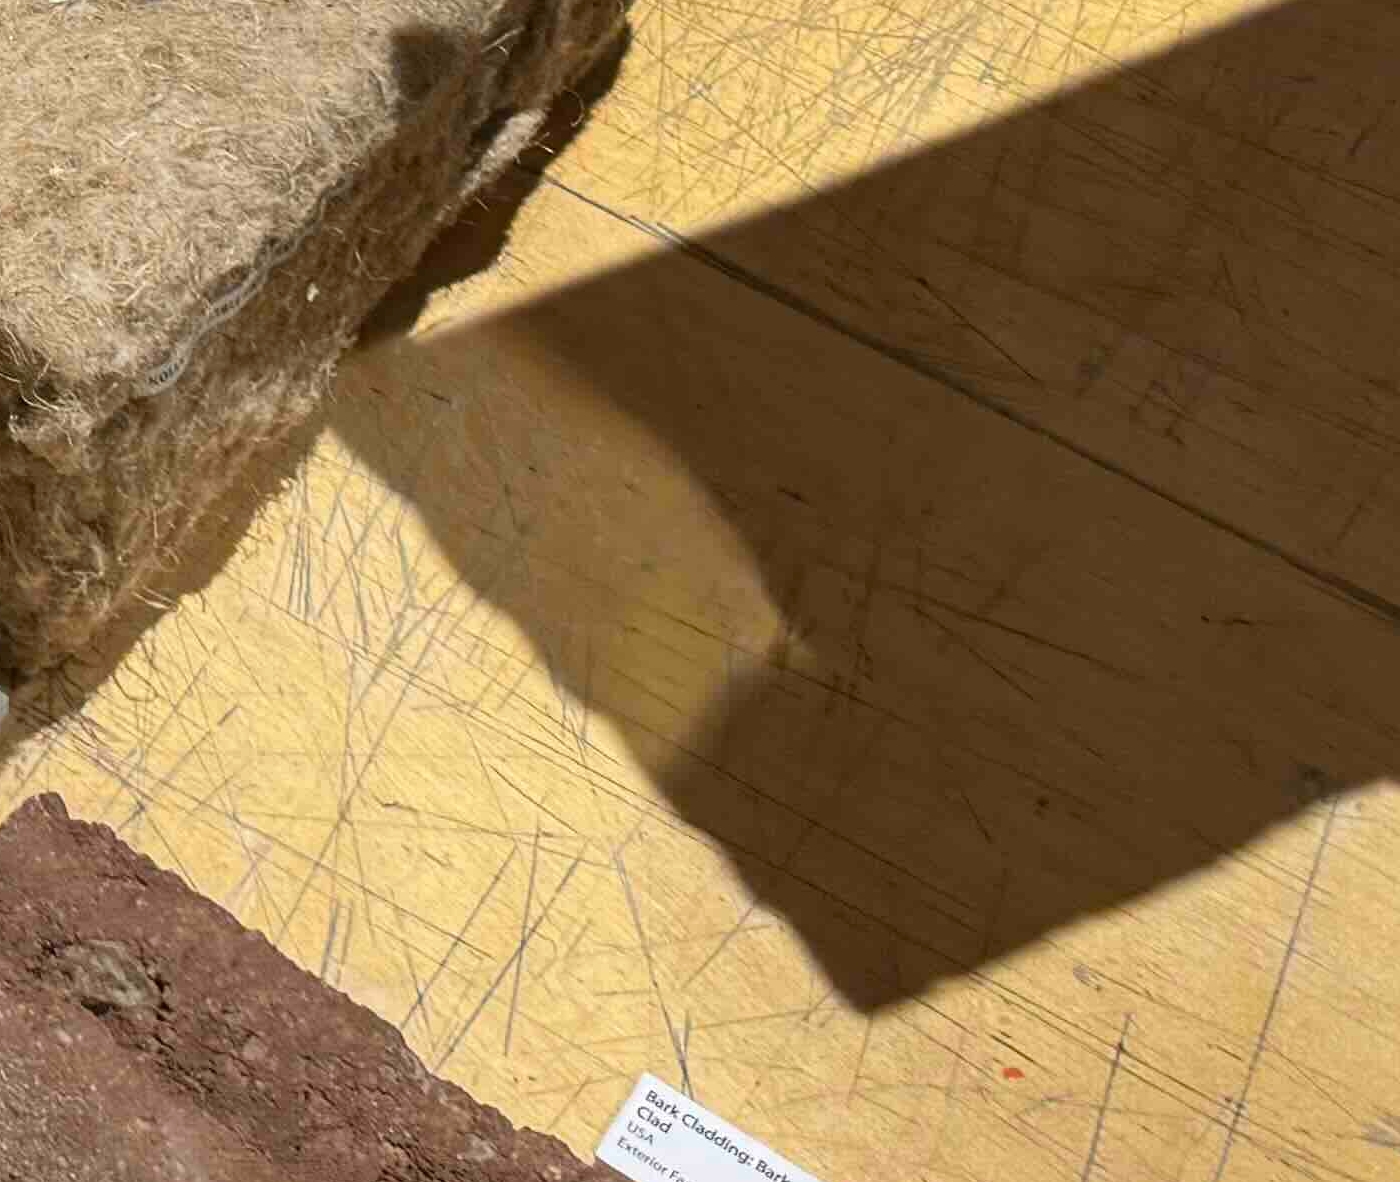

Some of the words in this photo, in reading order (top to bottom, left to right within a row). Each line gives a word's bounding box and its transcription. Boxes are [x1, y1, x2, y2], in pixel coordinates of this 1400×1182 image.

[626, 1121, 654, 1146] USA
[637, 1105, 673, 1134] Clad
[645, 1089, 679, 1120] Bark
[681, 1113, 754, 1166] Cladding:
[617, 1135, 668, 1175] Exterior
